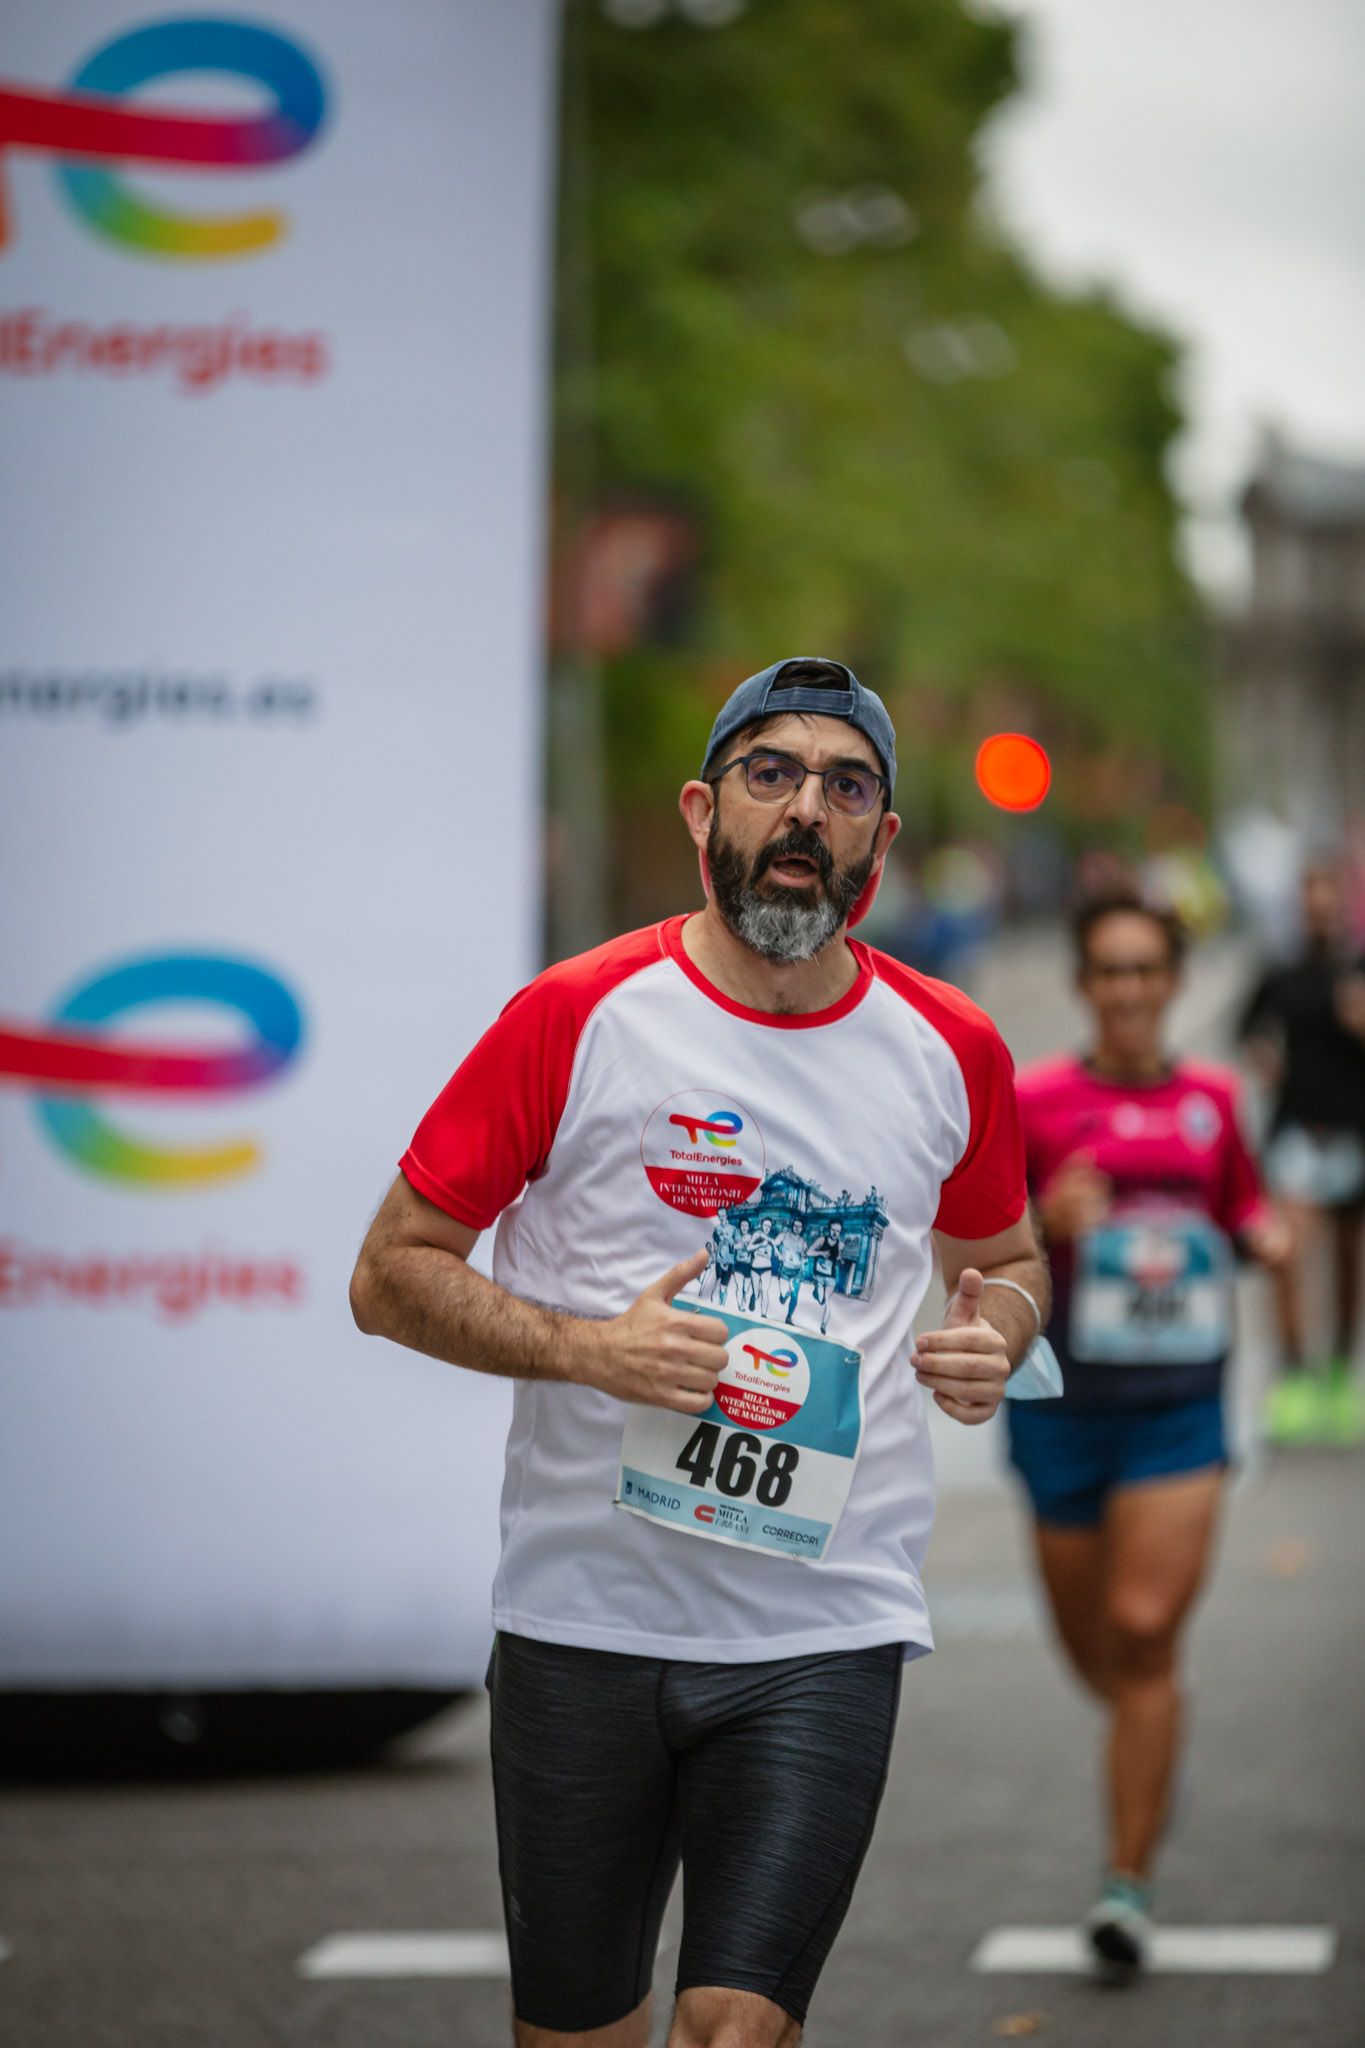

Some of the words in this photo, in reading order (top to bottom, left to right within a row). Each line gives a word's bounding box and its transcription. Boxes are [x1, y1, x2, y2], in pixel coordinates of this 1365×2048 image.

[669, 1149, 743, 1166] TotalEnergies
[685, 1173, 719, 1186] MILLA
[672, 1194, 689, 1205] DE
[734, 1371, 791, 1393] TotalEnergies
[743, 1391, 770, 1407] MILLA
[728, 1406, 740, 1417] DE
[741, 1409, 776, 1427] MADRID
[675, 1420, 800, 1508] 468
[637, 1486, 681, 1510] MADRID
[719, 1508, 748, 1524] MILLA
